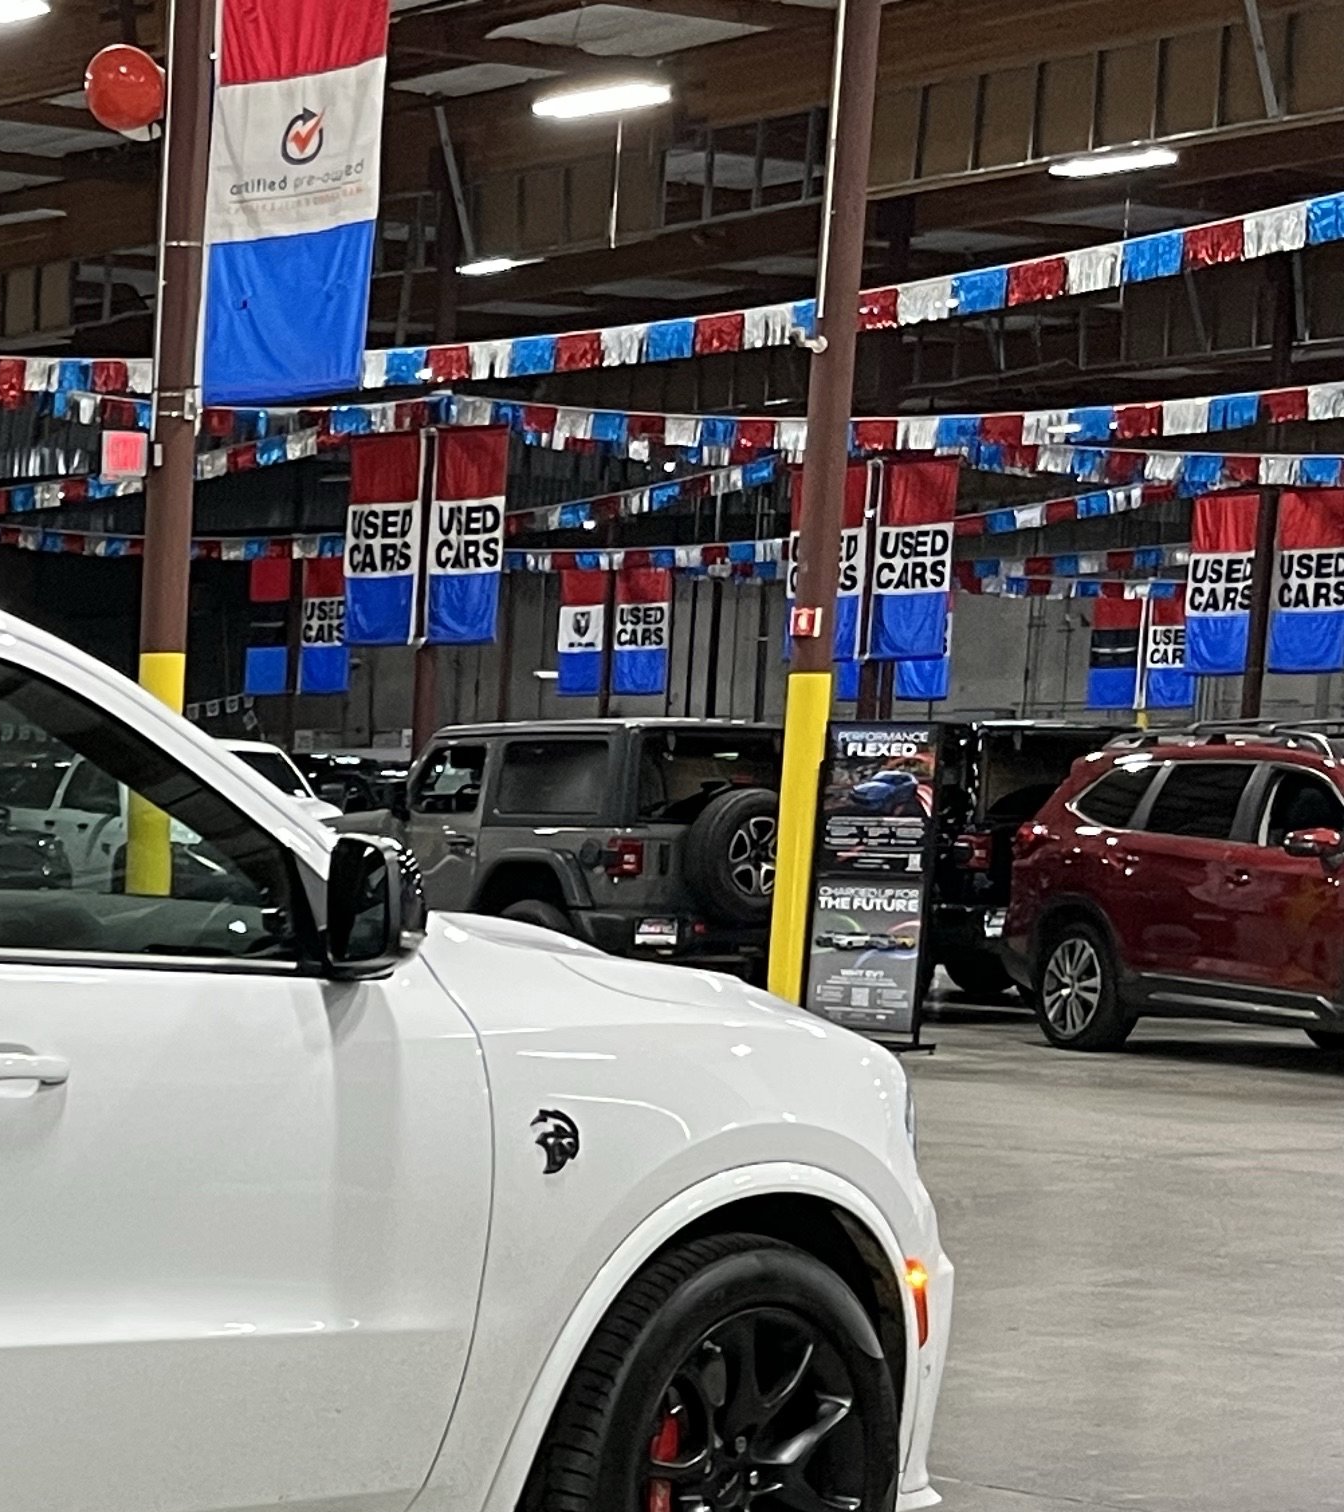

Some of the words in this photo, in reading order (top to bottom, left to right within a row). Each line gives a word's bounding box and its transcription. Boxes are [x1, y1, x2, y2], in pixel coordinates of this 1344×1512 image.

[351, 508, 413, 540] USED
[439, 504, 501, 536] USED
[349, 541, 411, 573] CARS
[435, 537, 499, 569] CARS
[880, 529, 949, 559] USED
[876, 560, 947, 590] CARS
[1192, 557, 1253, 584] USED
[1189, 586, 1253, 612] CARS
[1278, 581, 1344, 608] CARS
[619, 606, 665, 626] USED
[617, 627, 664, 646] CARS
[1153, 629, 1186, 646] USE
[1150, 648, 1185, 665] CAR
[847, 742, 918, 757] FLEXED
[818, 896, 851, 909] THE
[853, 898, 920, 912] FUTURE
[895, 889, 920, 899] FOR
